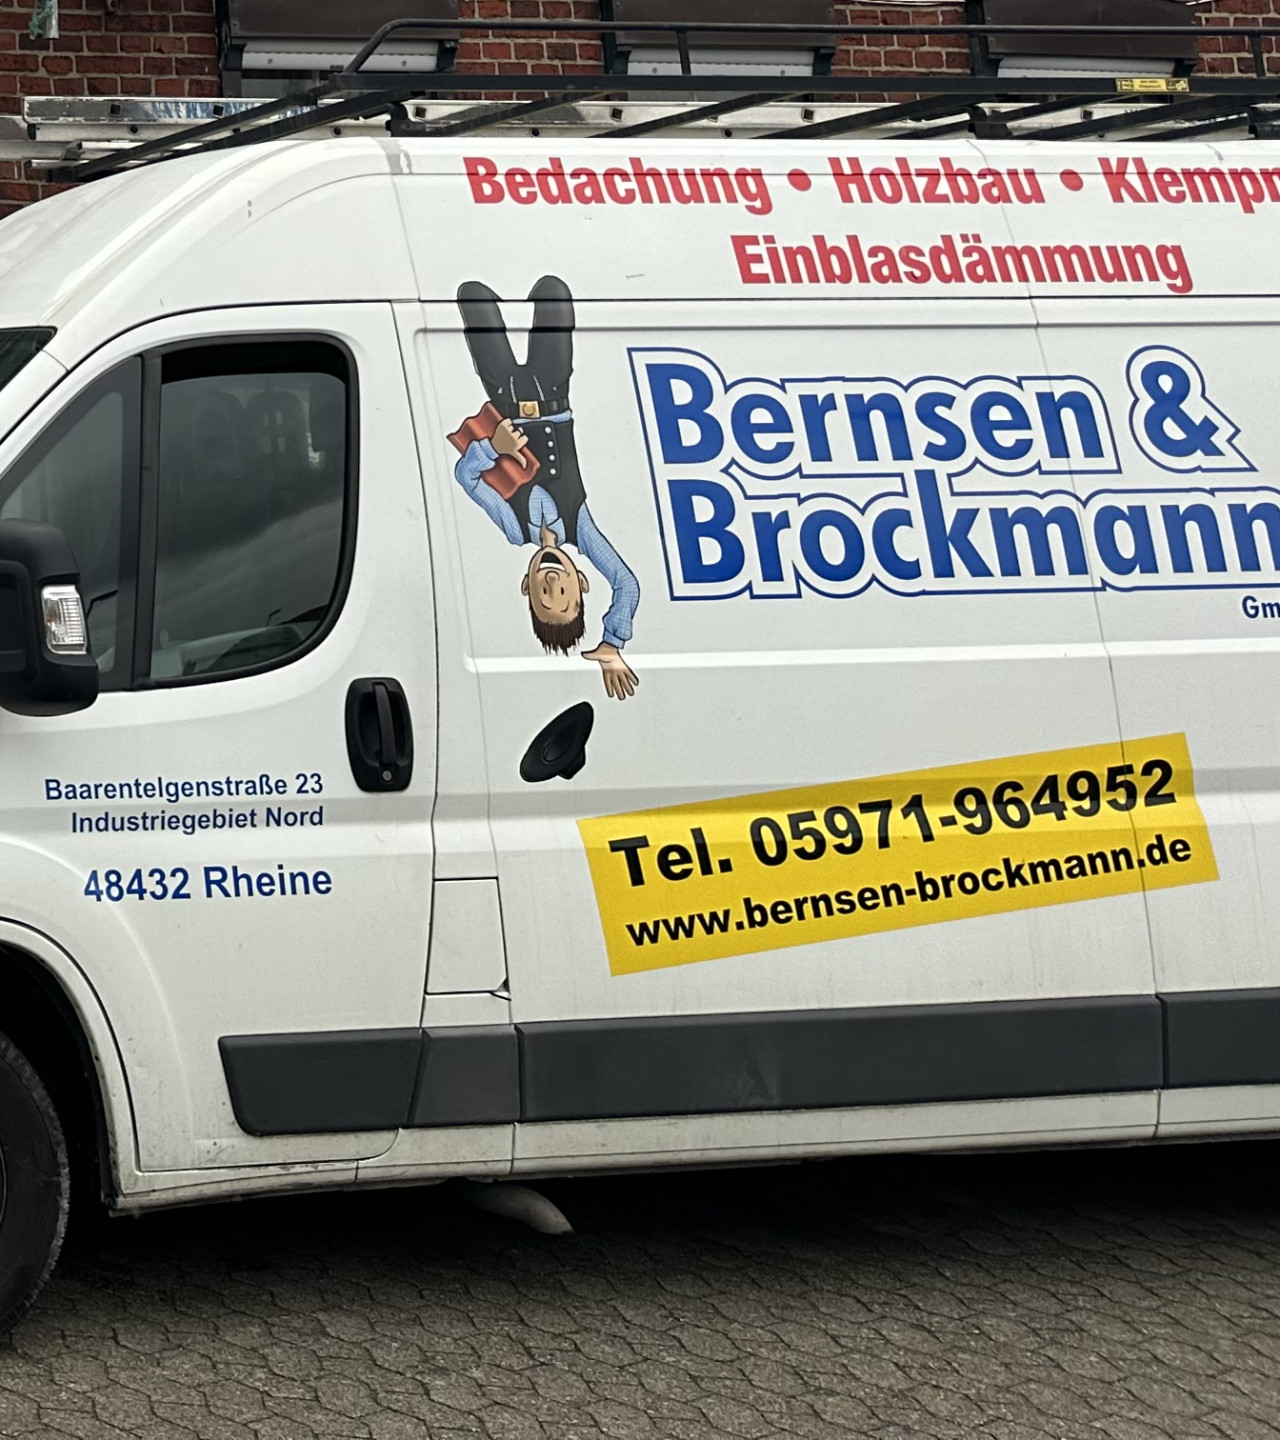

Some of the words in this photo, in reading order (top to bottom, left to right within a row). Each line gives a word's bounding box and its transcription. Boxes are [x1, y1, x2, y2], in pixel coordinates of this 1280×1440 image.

[463, 157, 774, 215] Bedachung
[827, 157, 1046, 205] Holzbau
[731, 234, 1194, 294] Einblasdämmung
[644, 362, 1106, 465] Bernsen
[1142, 359, 1236, 458] &
[667, 468, 1280, 584] Brockmann
[44, 773, 287, 806] Baarentelgenstraße
[295, 773, 324, 795] 23
[71, 807, 258, 835] Industriegebiet
[265, 805, 324, 828] Nord
[609, 827, 733, 888] Tel.
[749, 758, 1178, 867] 05971-964952
[83, 866, 191, 902] 48432
[203, 863, 333, 899] Rheine
[625, 832, 1193, 948] www.bernsen-brockmann.de
